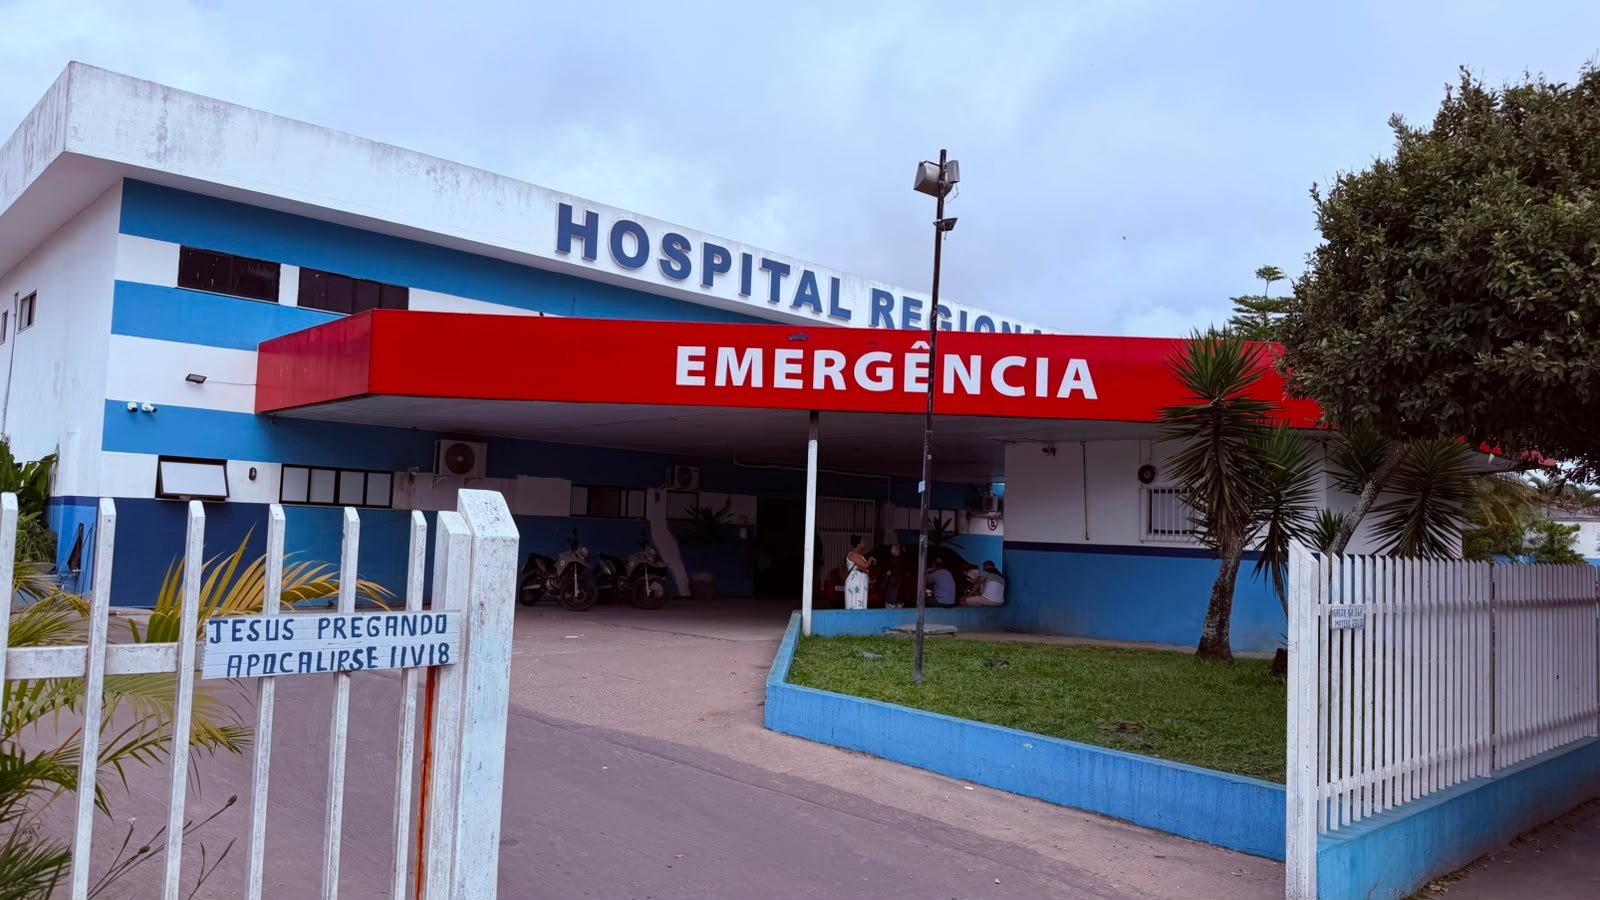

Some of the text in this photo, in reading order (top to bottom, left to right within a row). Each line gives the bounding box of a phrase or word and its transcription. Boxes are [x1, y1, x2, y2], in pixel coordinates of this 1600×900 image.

[555, 202, 1042, 335] HOSPITAL REGIO
[675, 340, 1098, 400] EMERGÊNCIA
[208, 613, 447, 644] JESUS PREGANDO
